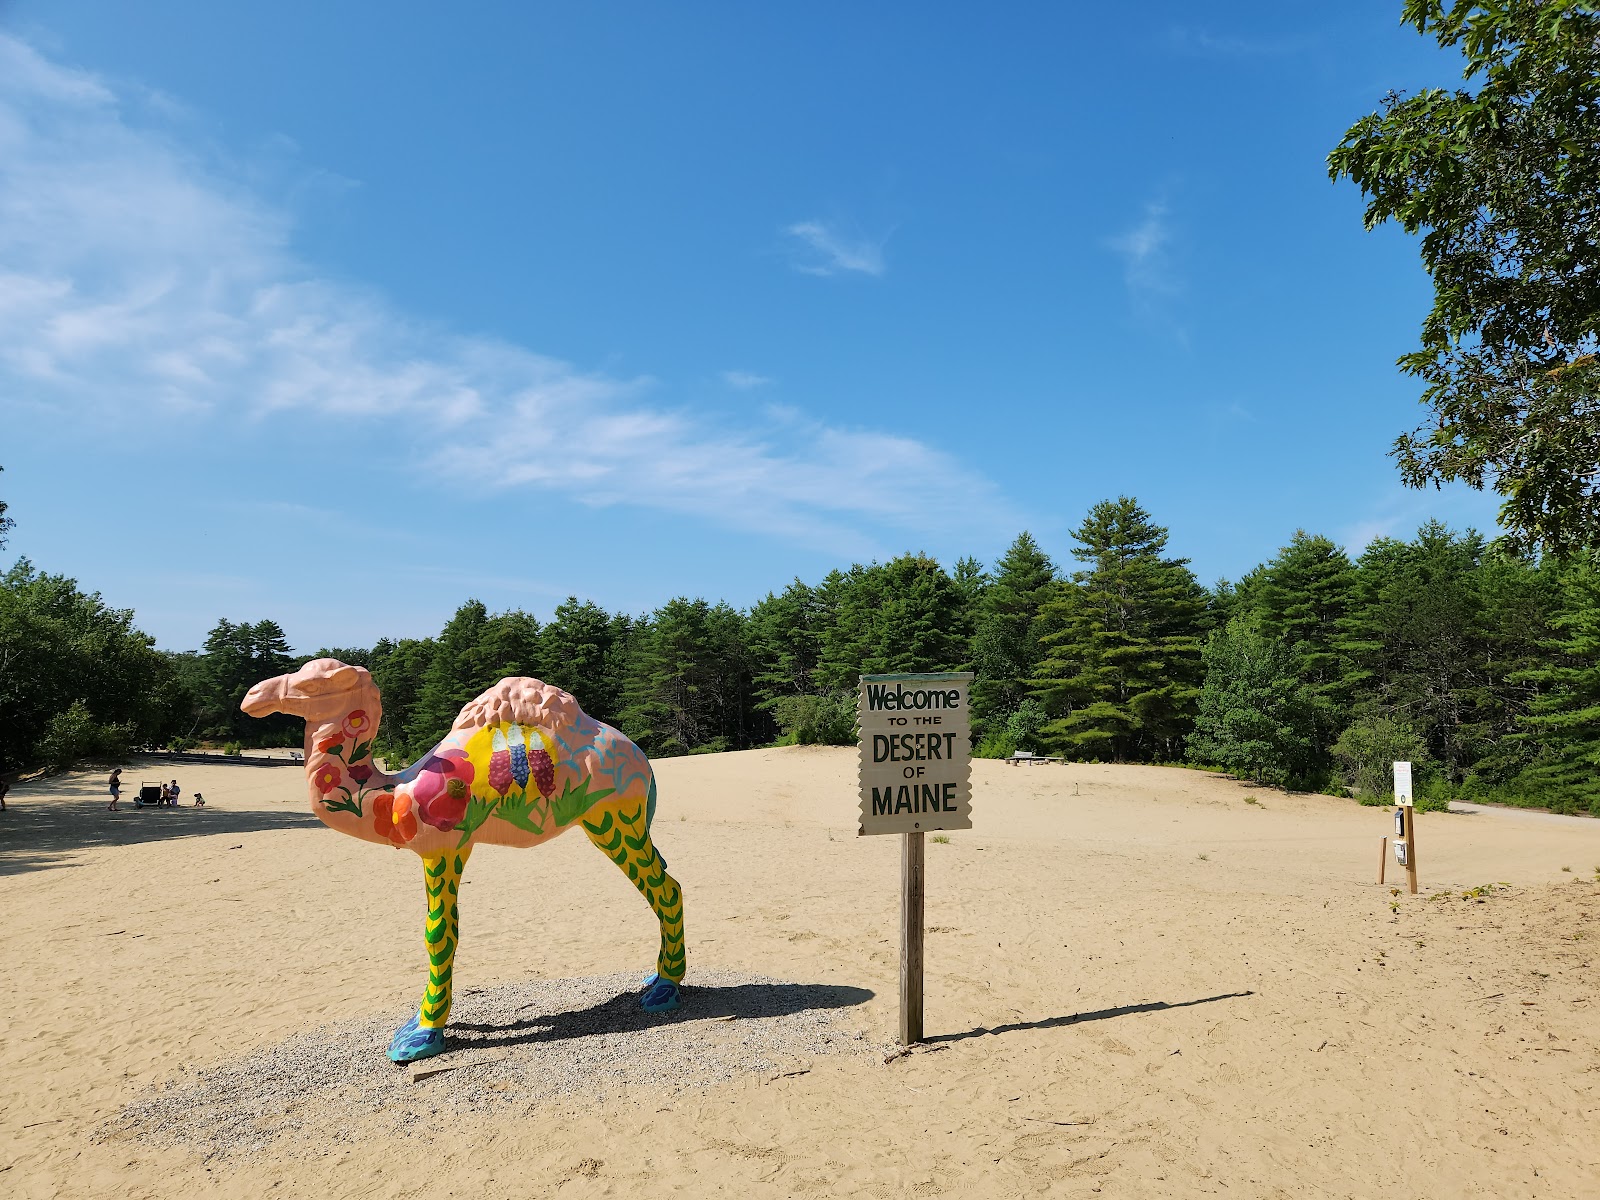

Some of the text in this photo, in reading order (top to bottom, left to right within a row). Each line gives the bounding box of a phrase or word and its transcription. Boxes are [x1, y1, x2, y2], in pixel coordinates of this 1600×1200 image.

[866, 684, 960, 711] Welcome
[888, 716, 942, 726] TO THE
[873, 733, 957, 763] DESERT
[903, 766, 926, 779] OF
[872, 783, 958, 816] MAINE
